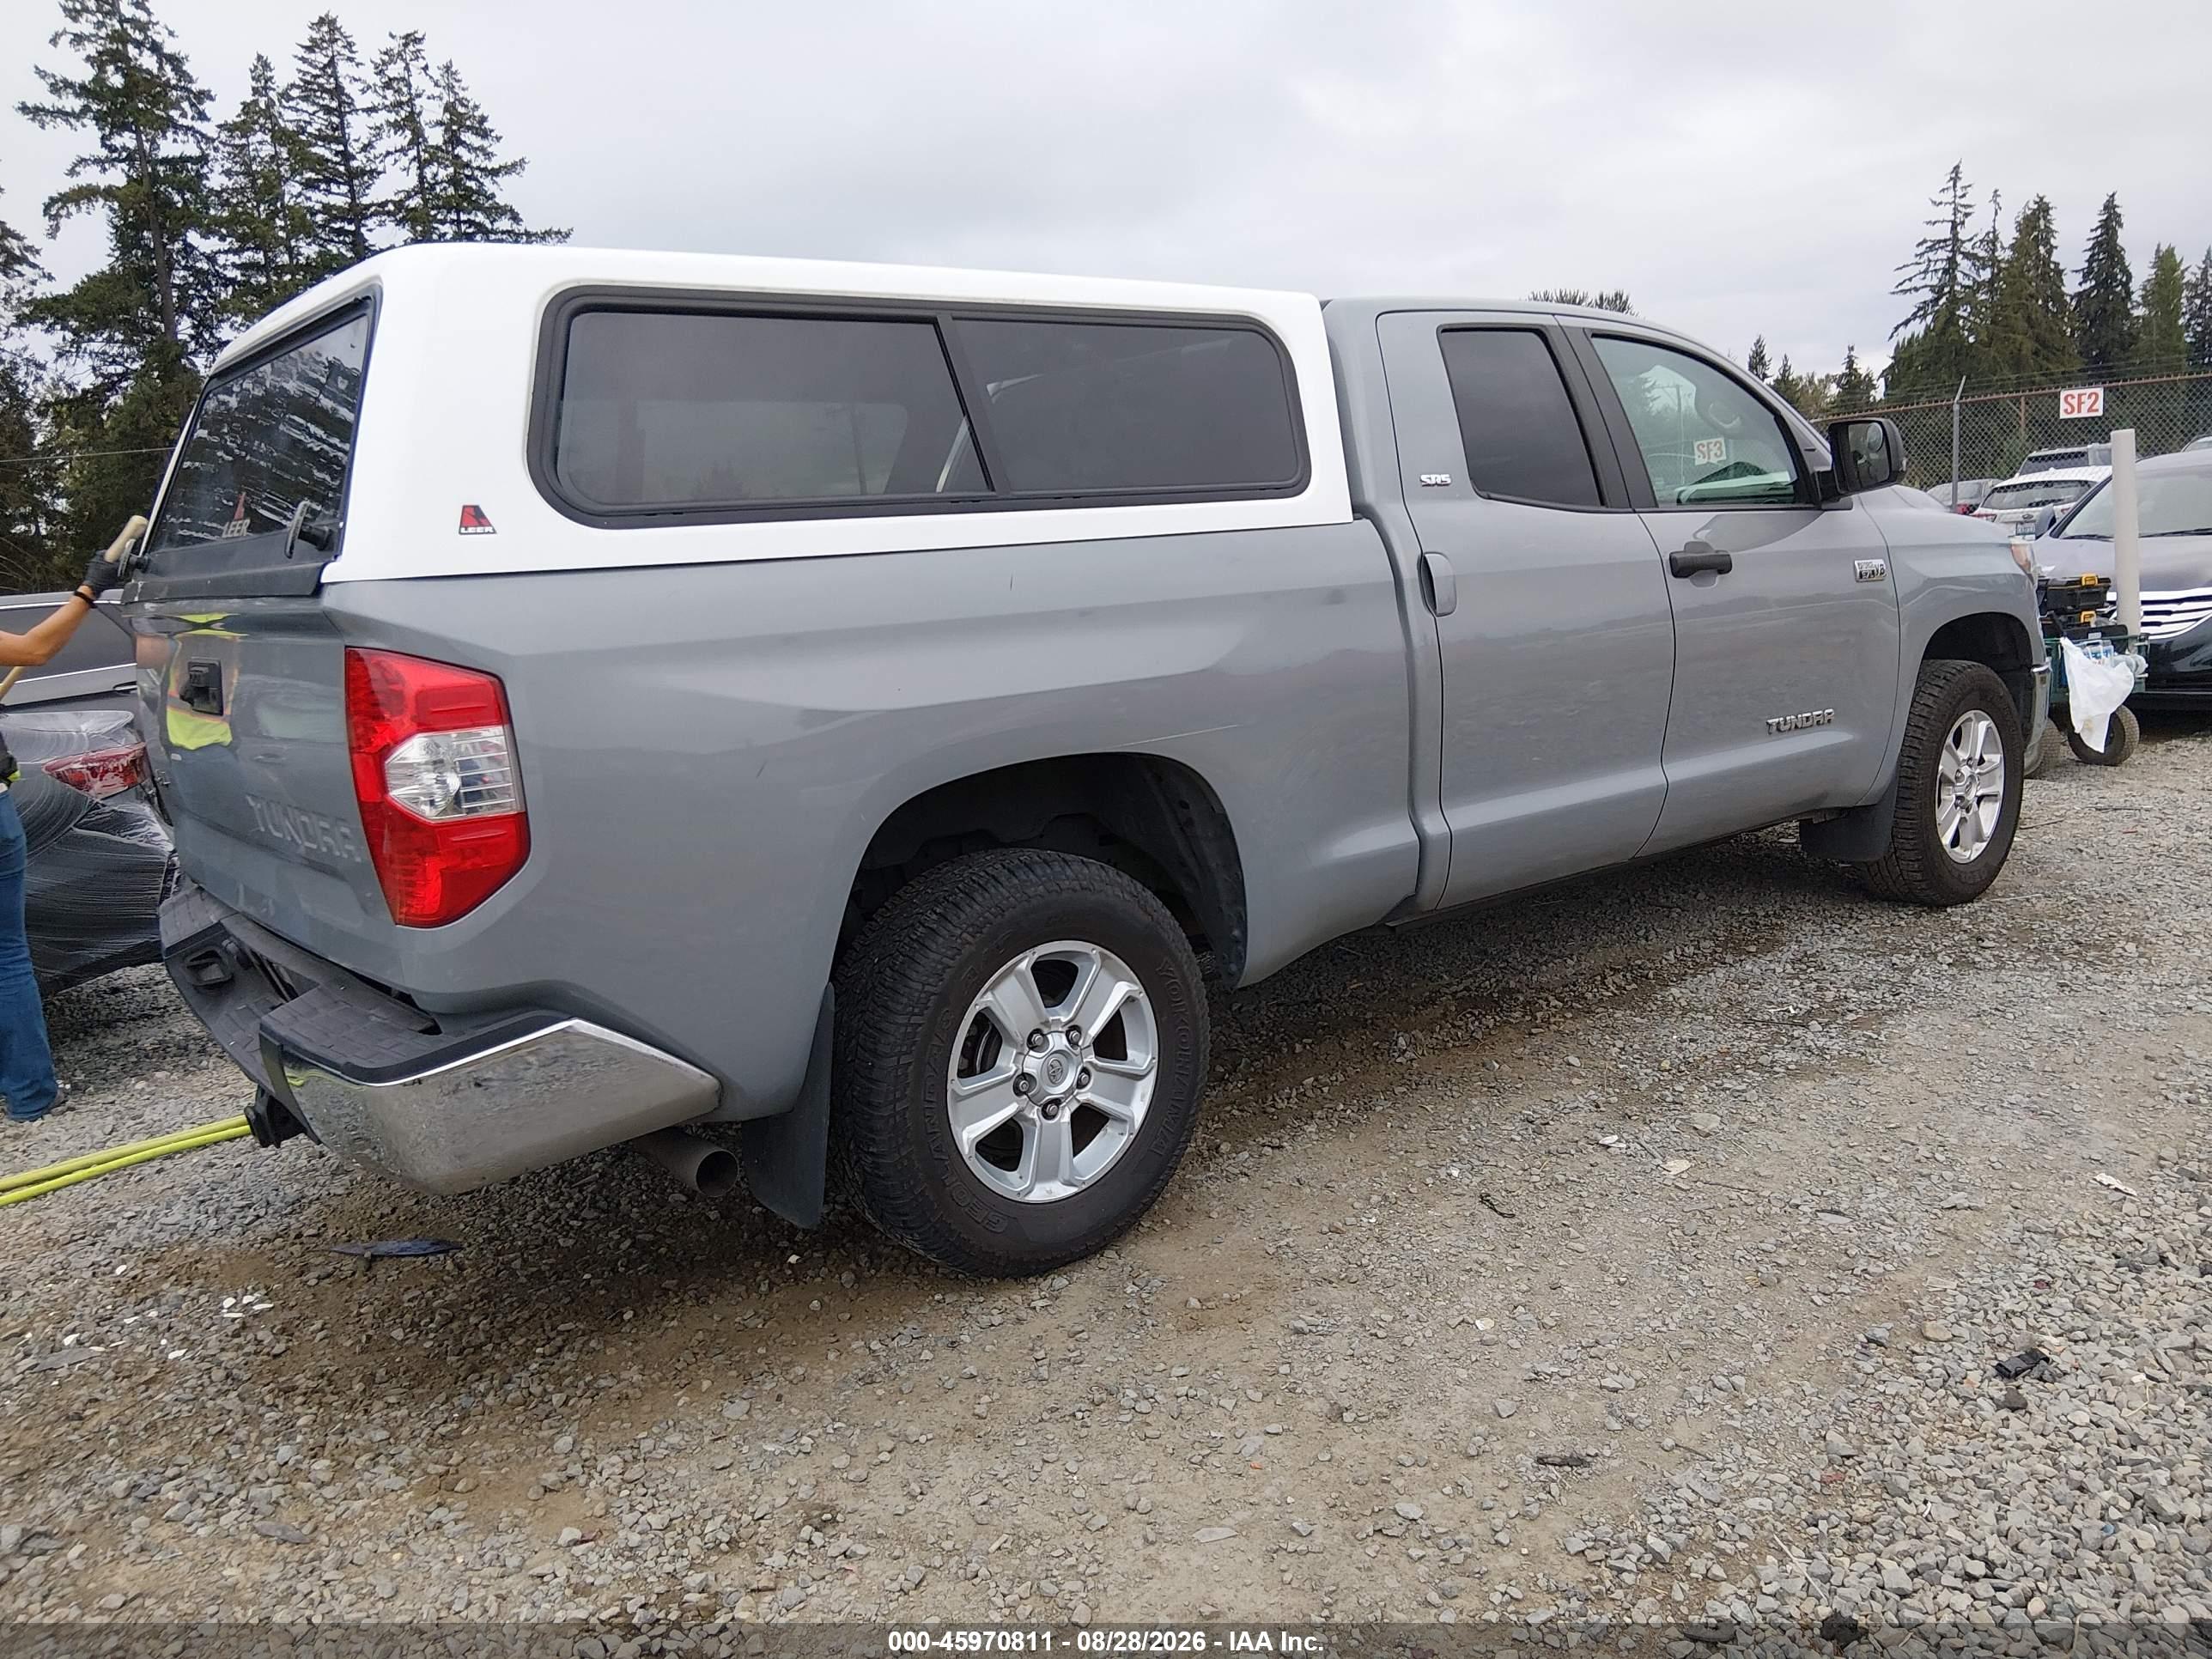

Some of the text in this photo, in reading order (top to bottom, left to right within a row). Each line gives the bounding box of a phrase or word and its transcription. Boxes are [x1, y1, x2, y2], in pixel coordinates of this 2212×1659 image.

[2063, 392, 2100, 415] SF2
[1697, 441, 1723, 461] SF3
[222, 519, 251, 538] LEER
[1765, 708, 1835, 735] TUNDRA
[246, 794, 362, 863] TUNDRA
[1149, 957, 1192, 1156] YOKOHAMA
